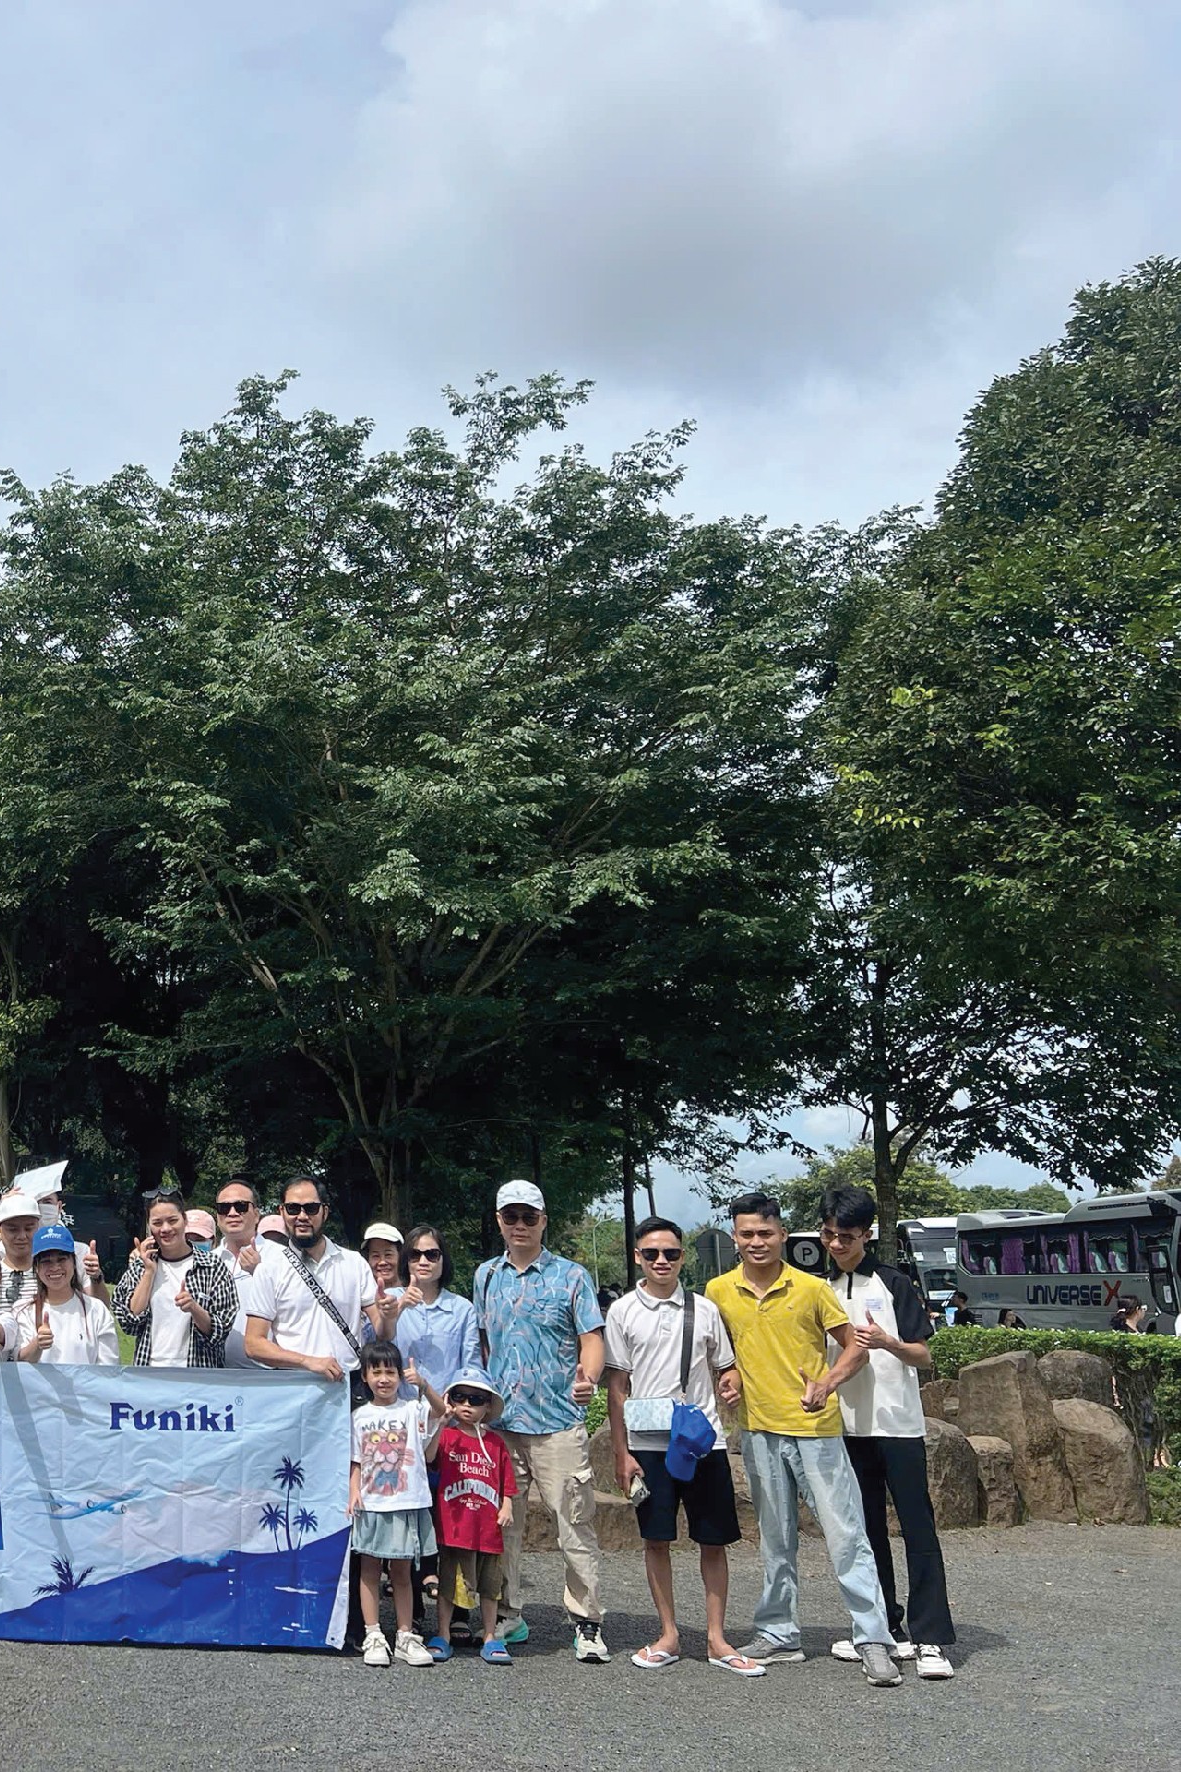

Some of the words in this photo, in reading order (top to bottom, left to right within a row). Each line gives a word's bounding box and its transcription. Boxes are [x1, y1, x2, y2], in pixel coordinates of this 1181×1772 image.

[802, 1247, 814, 1261] P
[1026, 1285, 1102, 1306] UNIVERSE
[110, 1402, 235, 1432] Funiki
[459, 1462, 490, 1478] Beach
